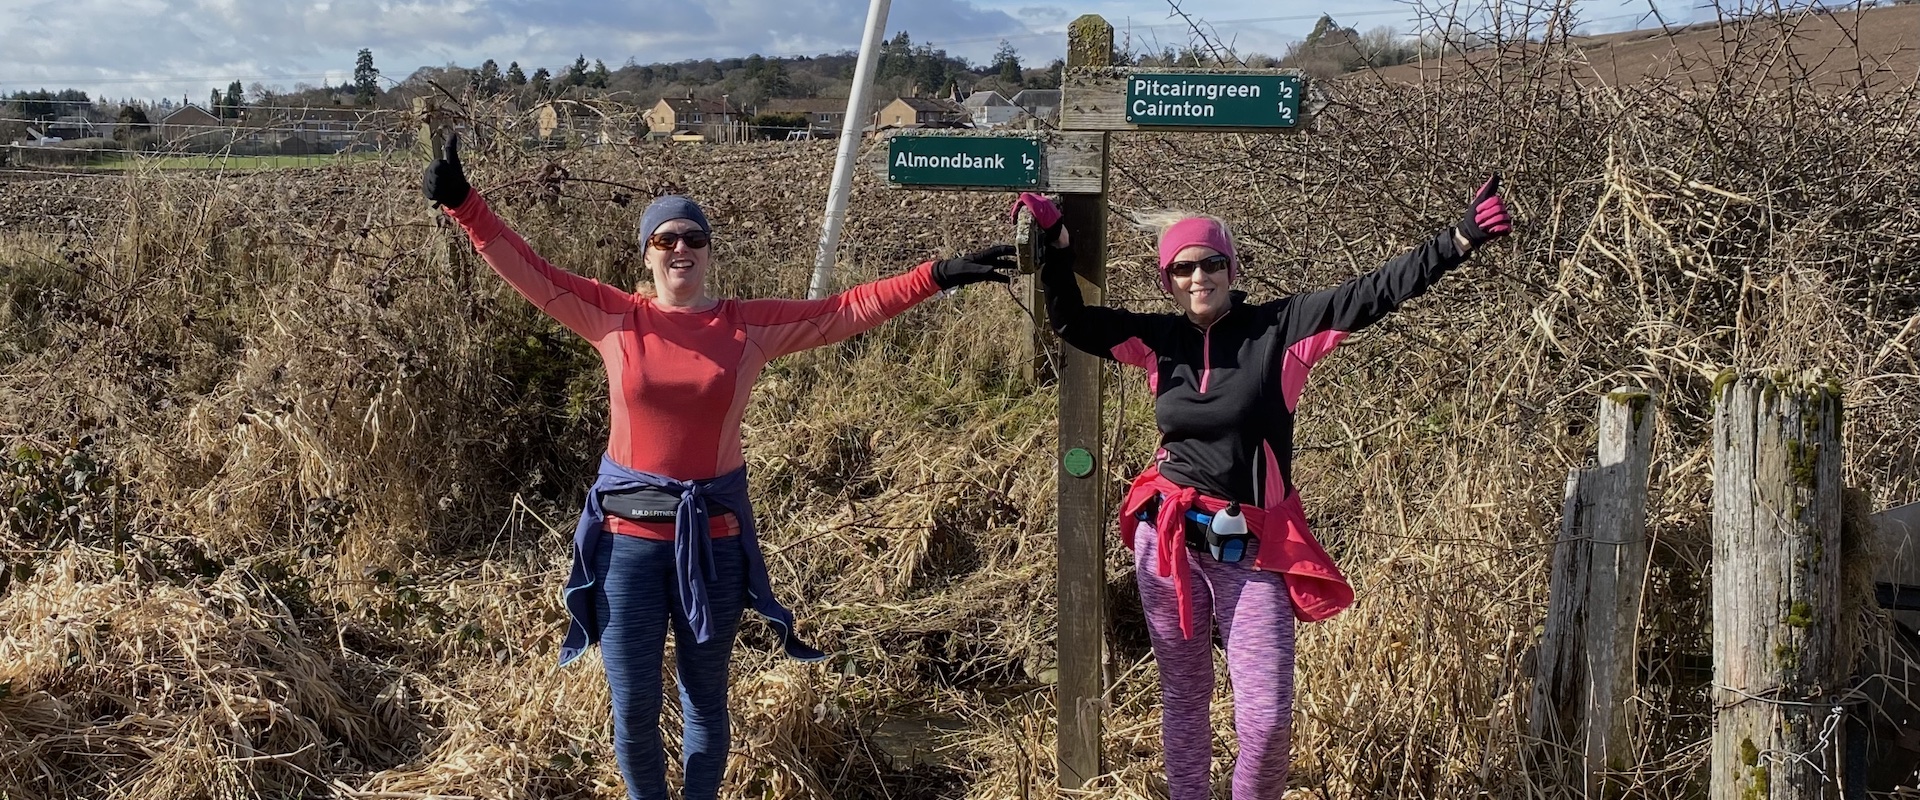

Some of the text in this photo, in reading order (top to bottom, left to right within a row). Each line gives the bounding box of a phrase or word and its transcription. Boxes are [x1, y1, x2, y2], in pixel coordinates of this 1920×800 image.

[1134, 79, 1260, 100] Pitcairngreen
[1132, 99, 1215, 117] Cairnton
[894, 151, 1005, 169] Almondbank
[631, 508, 649, 516] BUILD
